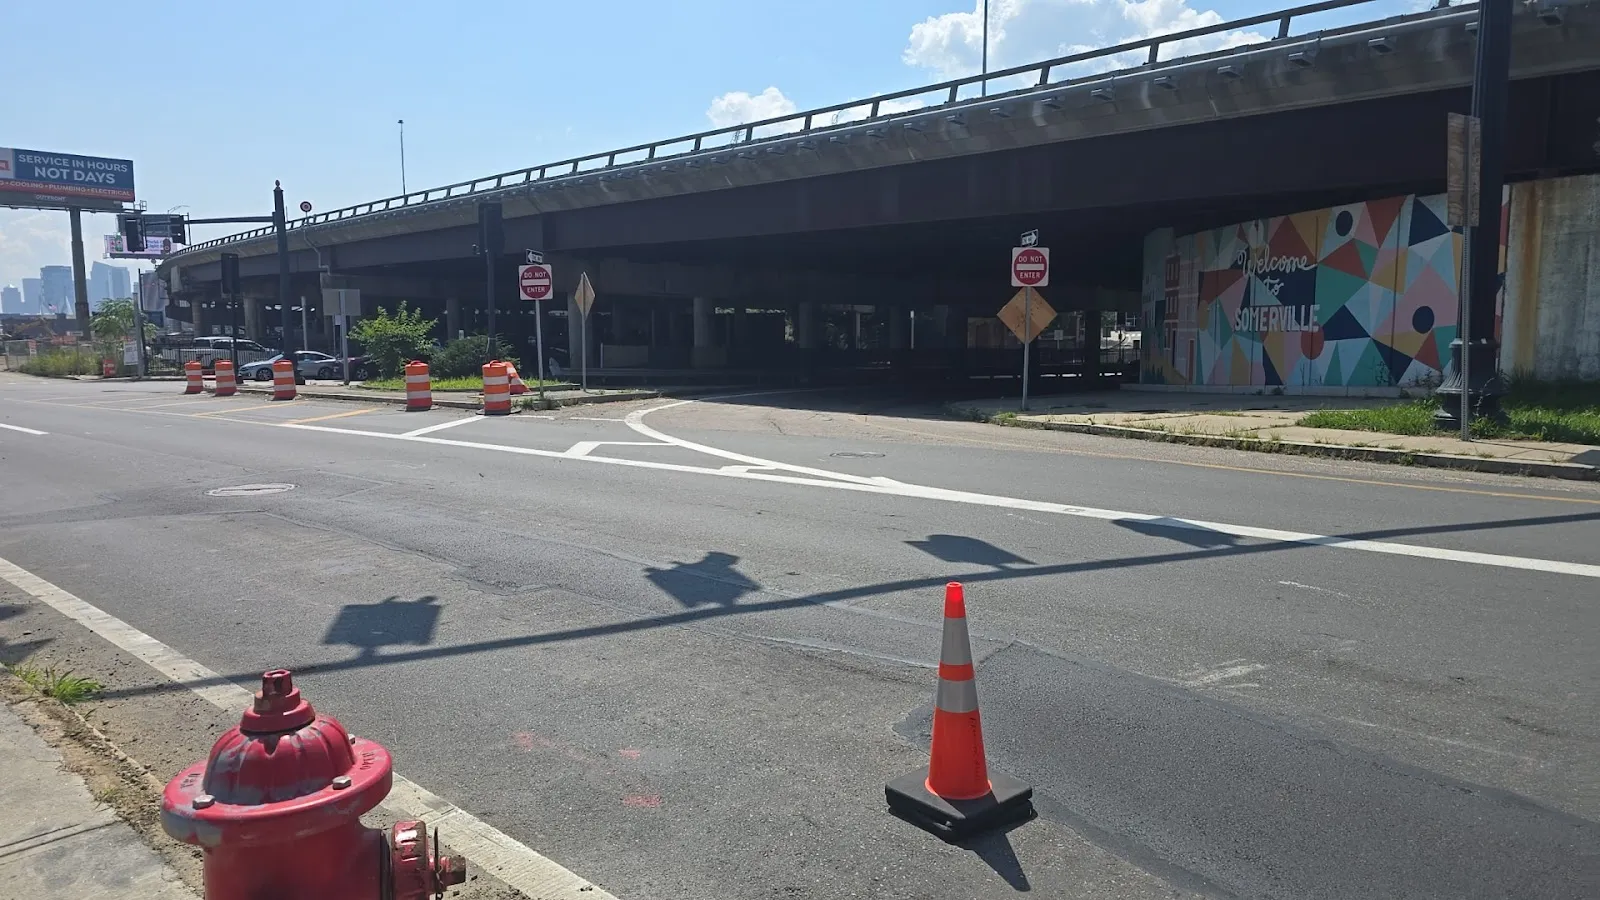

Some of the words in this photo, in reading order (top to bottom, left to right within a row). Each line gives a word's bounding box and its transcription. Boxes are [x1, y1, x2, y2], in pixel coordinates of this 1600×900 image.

[19, 154, 69, 166] SERVICE
[72, 159, 84, 168] IN
[87, 161, 128, 173] HOURS
[35, 166, 70, 179] NOT
[74, 170, 115, 184] DAYS
[49, 184, 86, 192] PLUMBING
[91, 188, 130, 196] ELECTRICAL
[1237, 244, 1319, 277] Welcome
[1264, 275, 1285, 295] to
